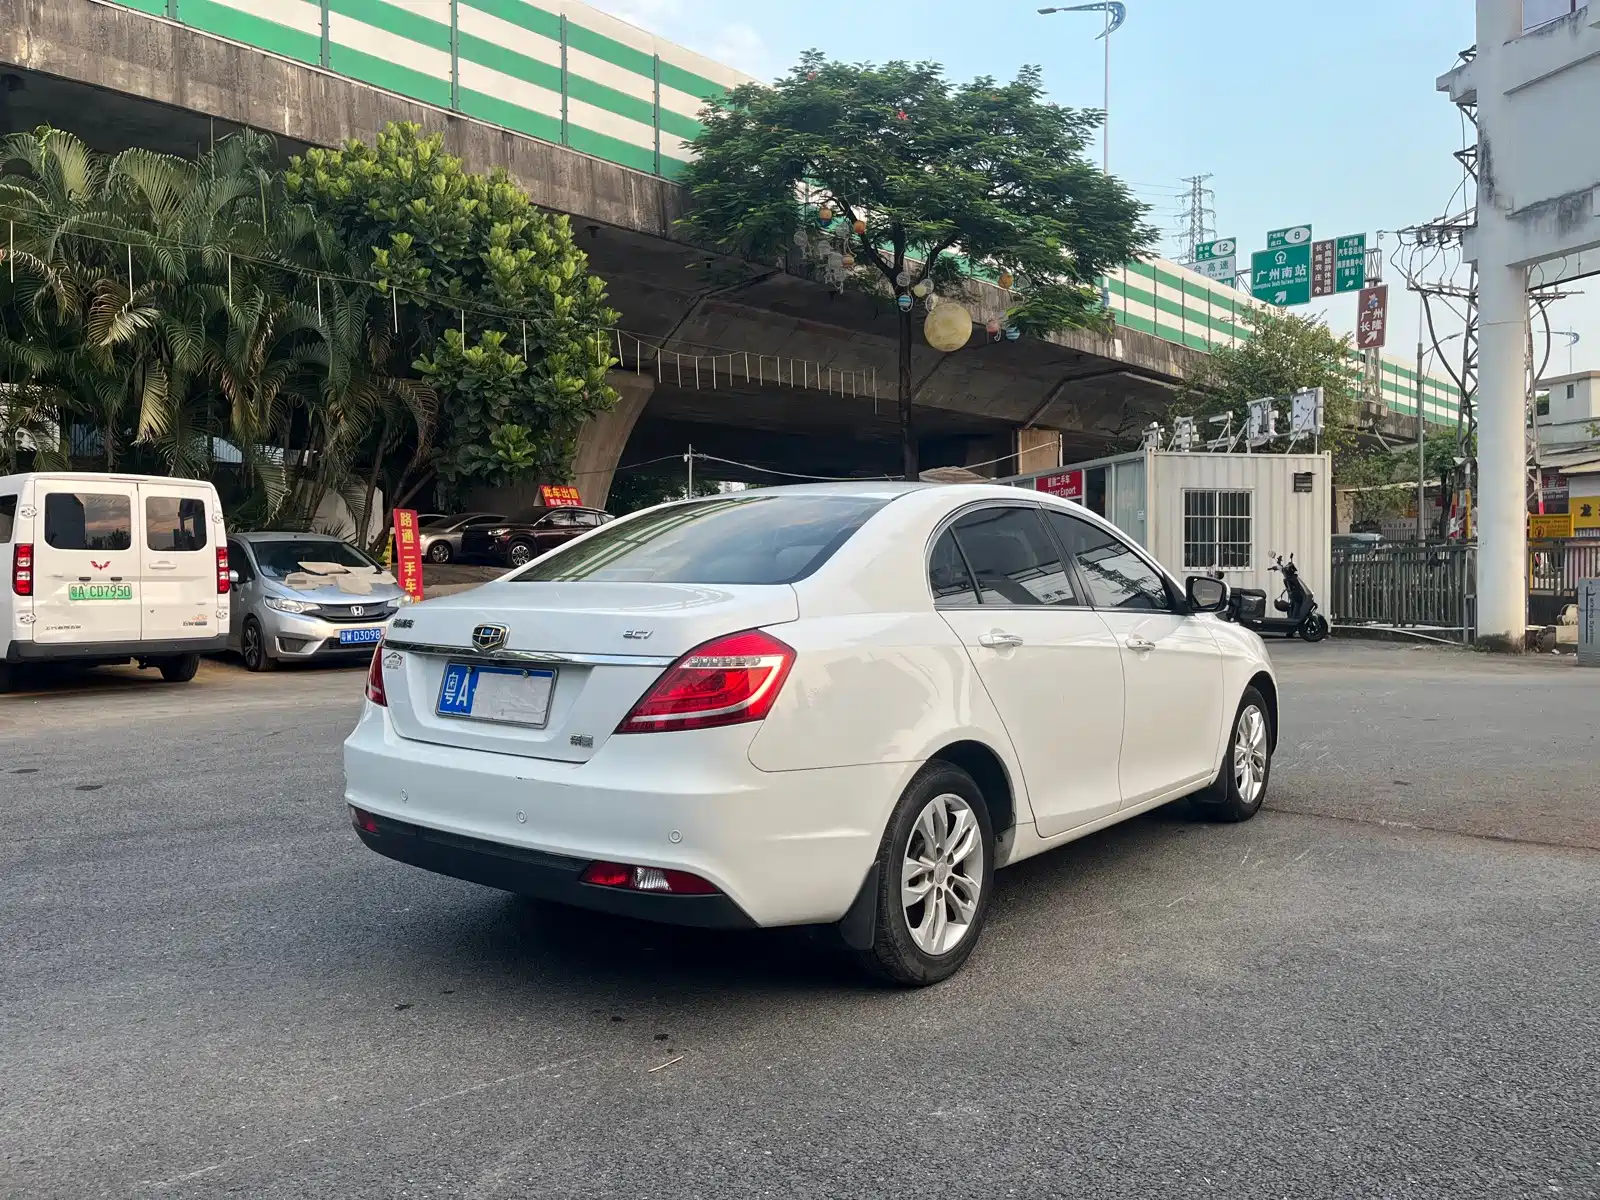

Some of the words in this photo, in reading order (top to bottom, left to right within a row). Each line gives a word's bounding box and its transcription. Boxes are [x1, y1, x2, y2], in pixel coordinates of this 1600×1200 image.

[1294, 231, 1301, 240] 8
[1218, 243, 1229, 253] 12
[1256, 263, 1308, 283] 广州南站
[1360, 307, 1384, 322] 广州
[1360, 319, 1384, 333] 长隆
[543, 486, 579, 499] 此车出售
[1060, 485, 1077, 498] Export
[400, 512, 417, 593] 路通二手车
[623, 629, 654, 639] EC7
